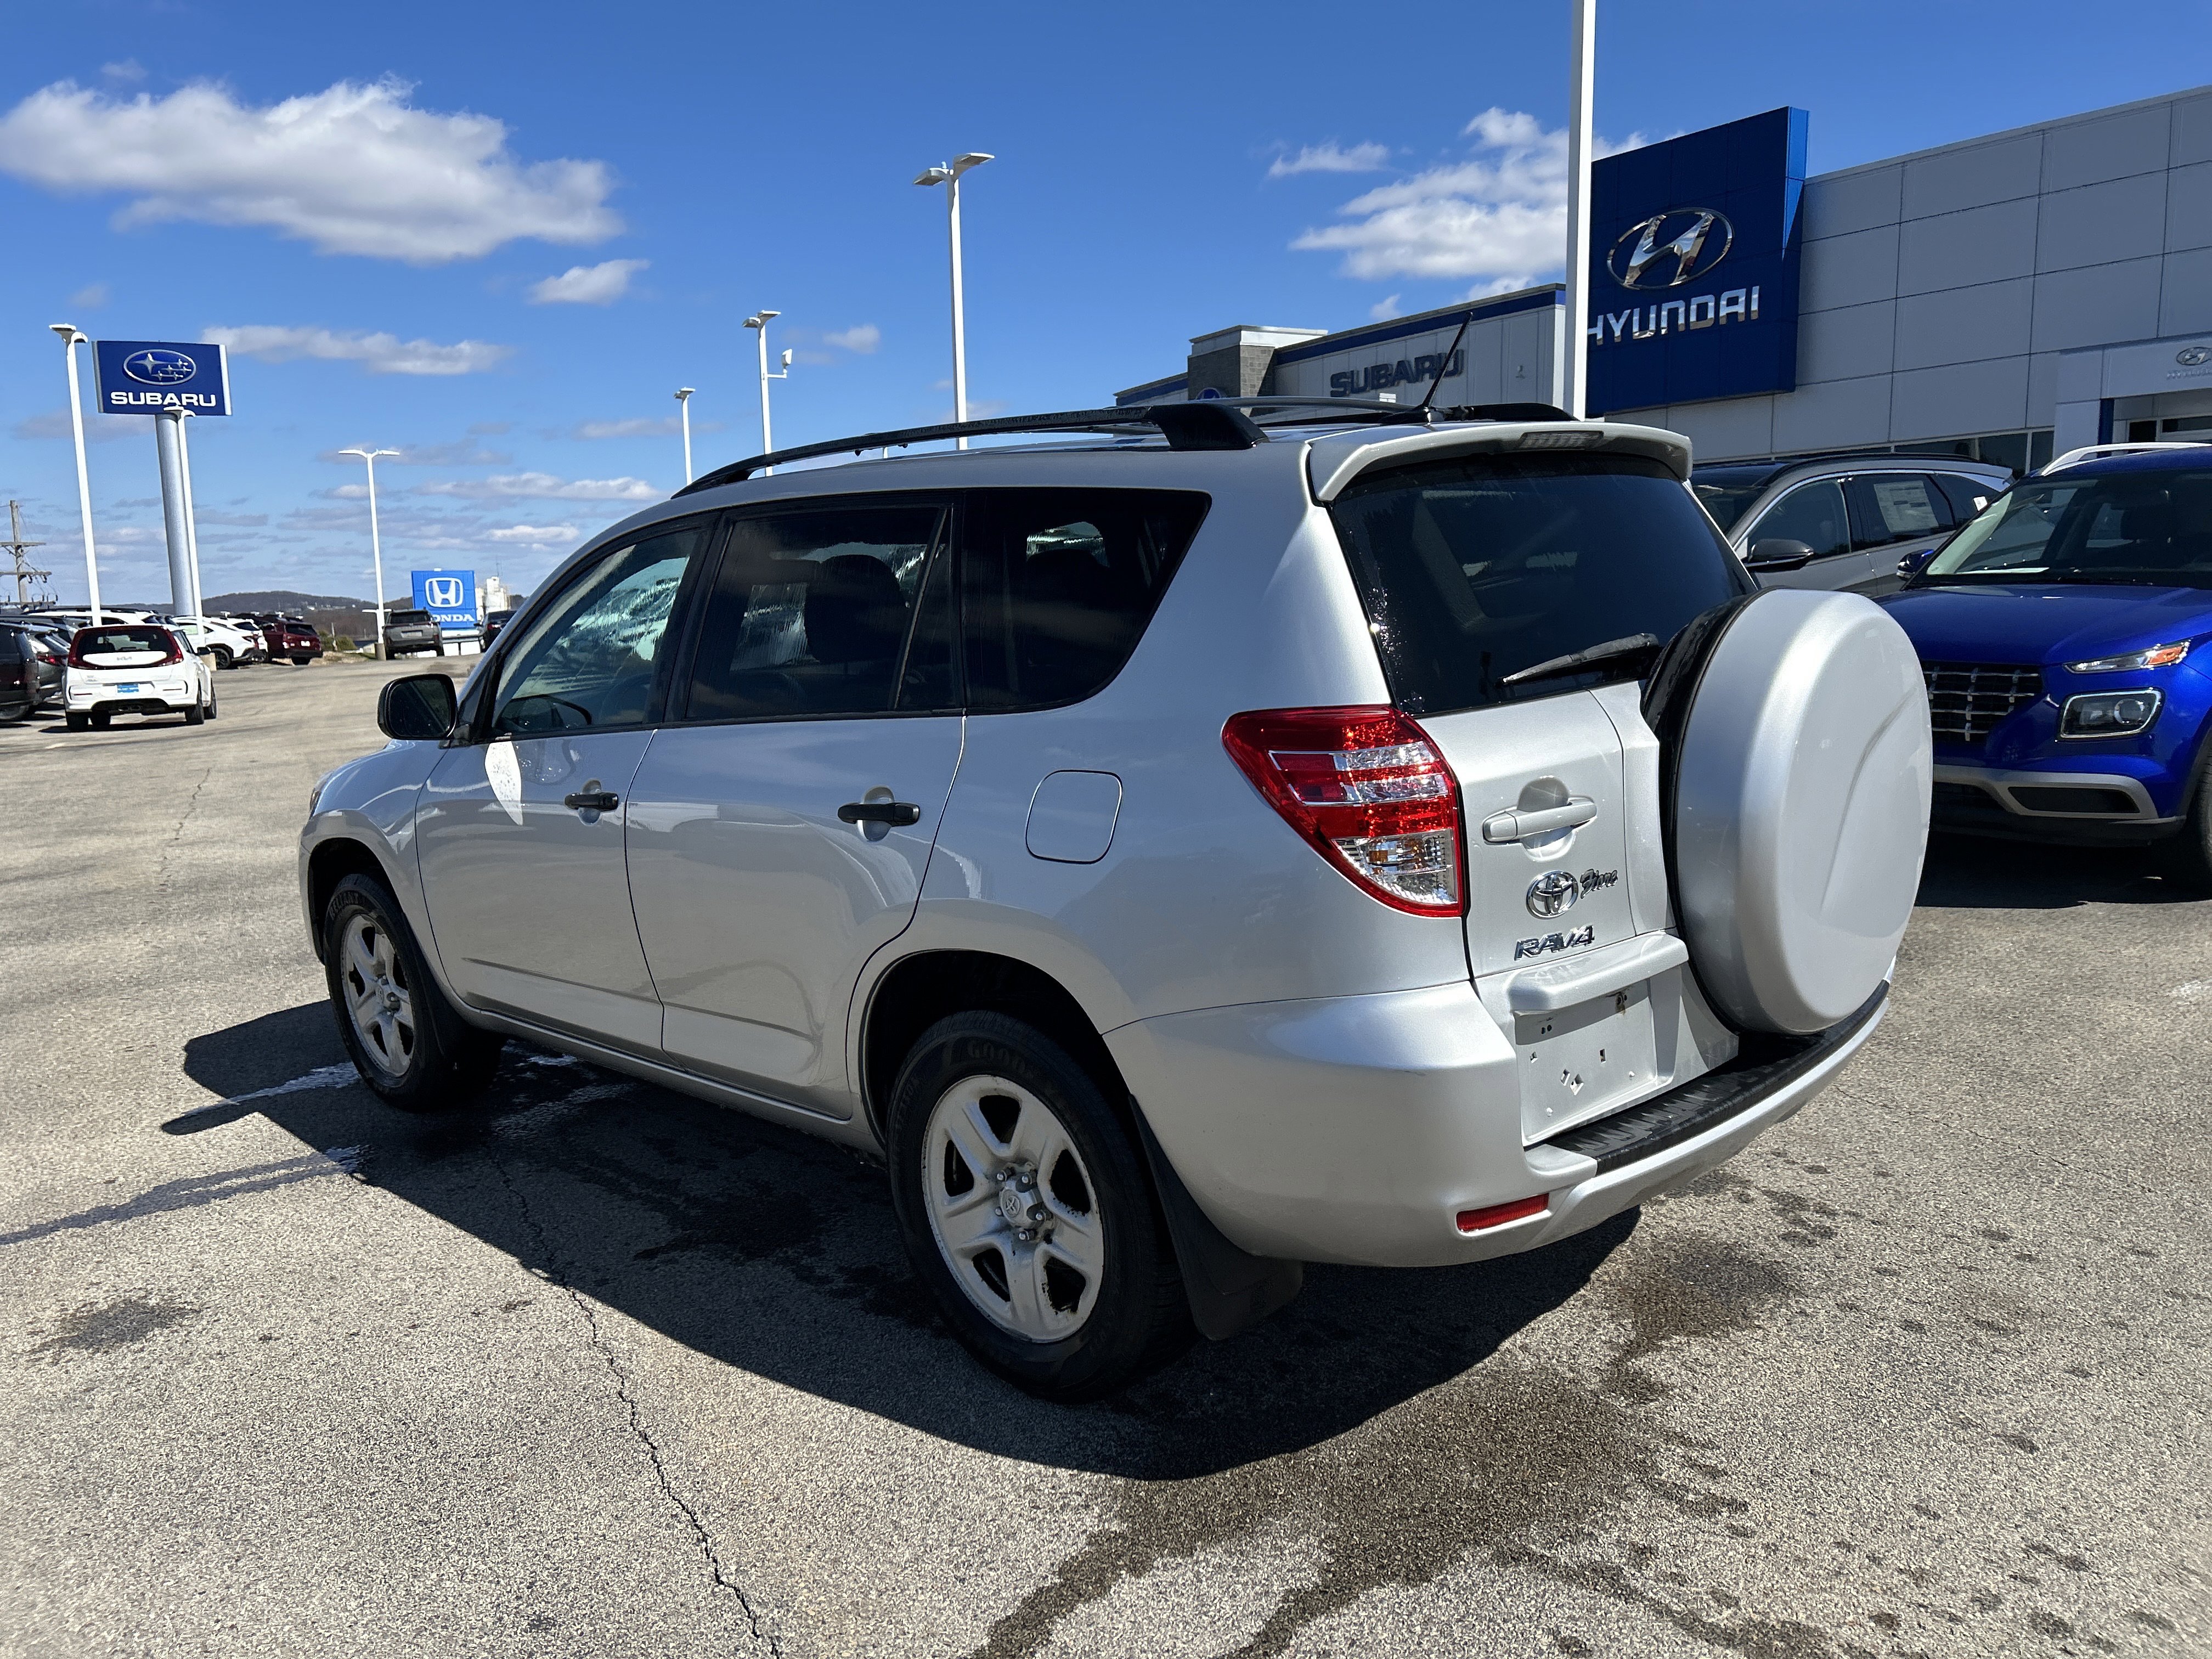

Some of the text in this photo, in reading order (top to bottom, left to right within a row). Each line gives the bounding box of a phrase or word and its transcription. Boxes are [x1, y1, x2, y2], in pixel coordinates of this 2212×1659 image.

[1588, 286, 1759, 345] HYUNDAI
[1330, 349, 1464, 397] SUBARU
[111, 392, 216, 407] SUBARU
[432, 614, 475, 622] ONDA
[1514, 924, 1595, 961] RAV4
